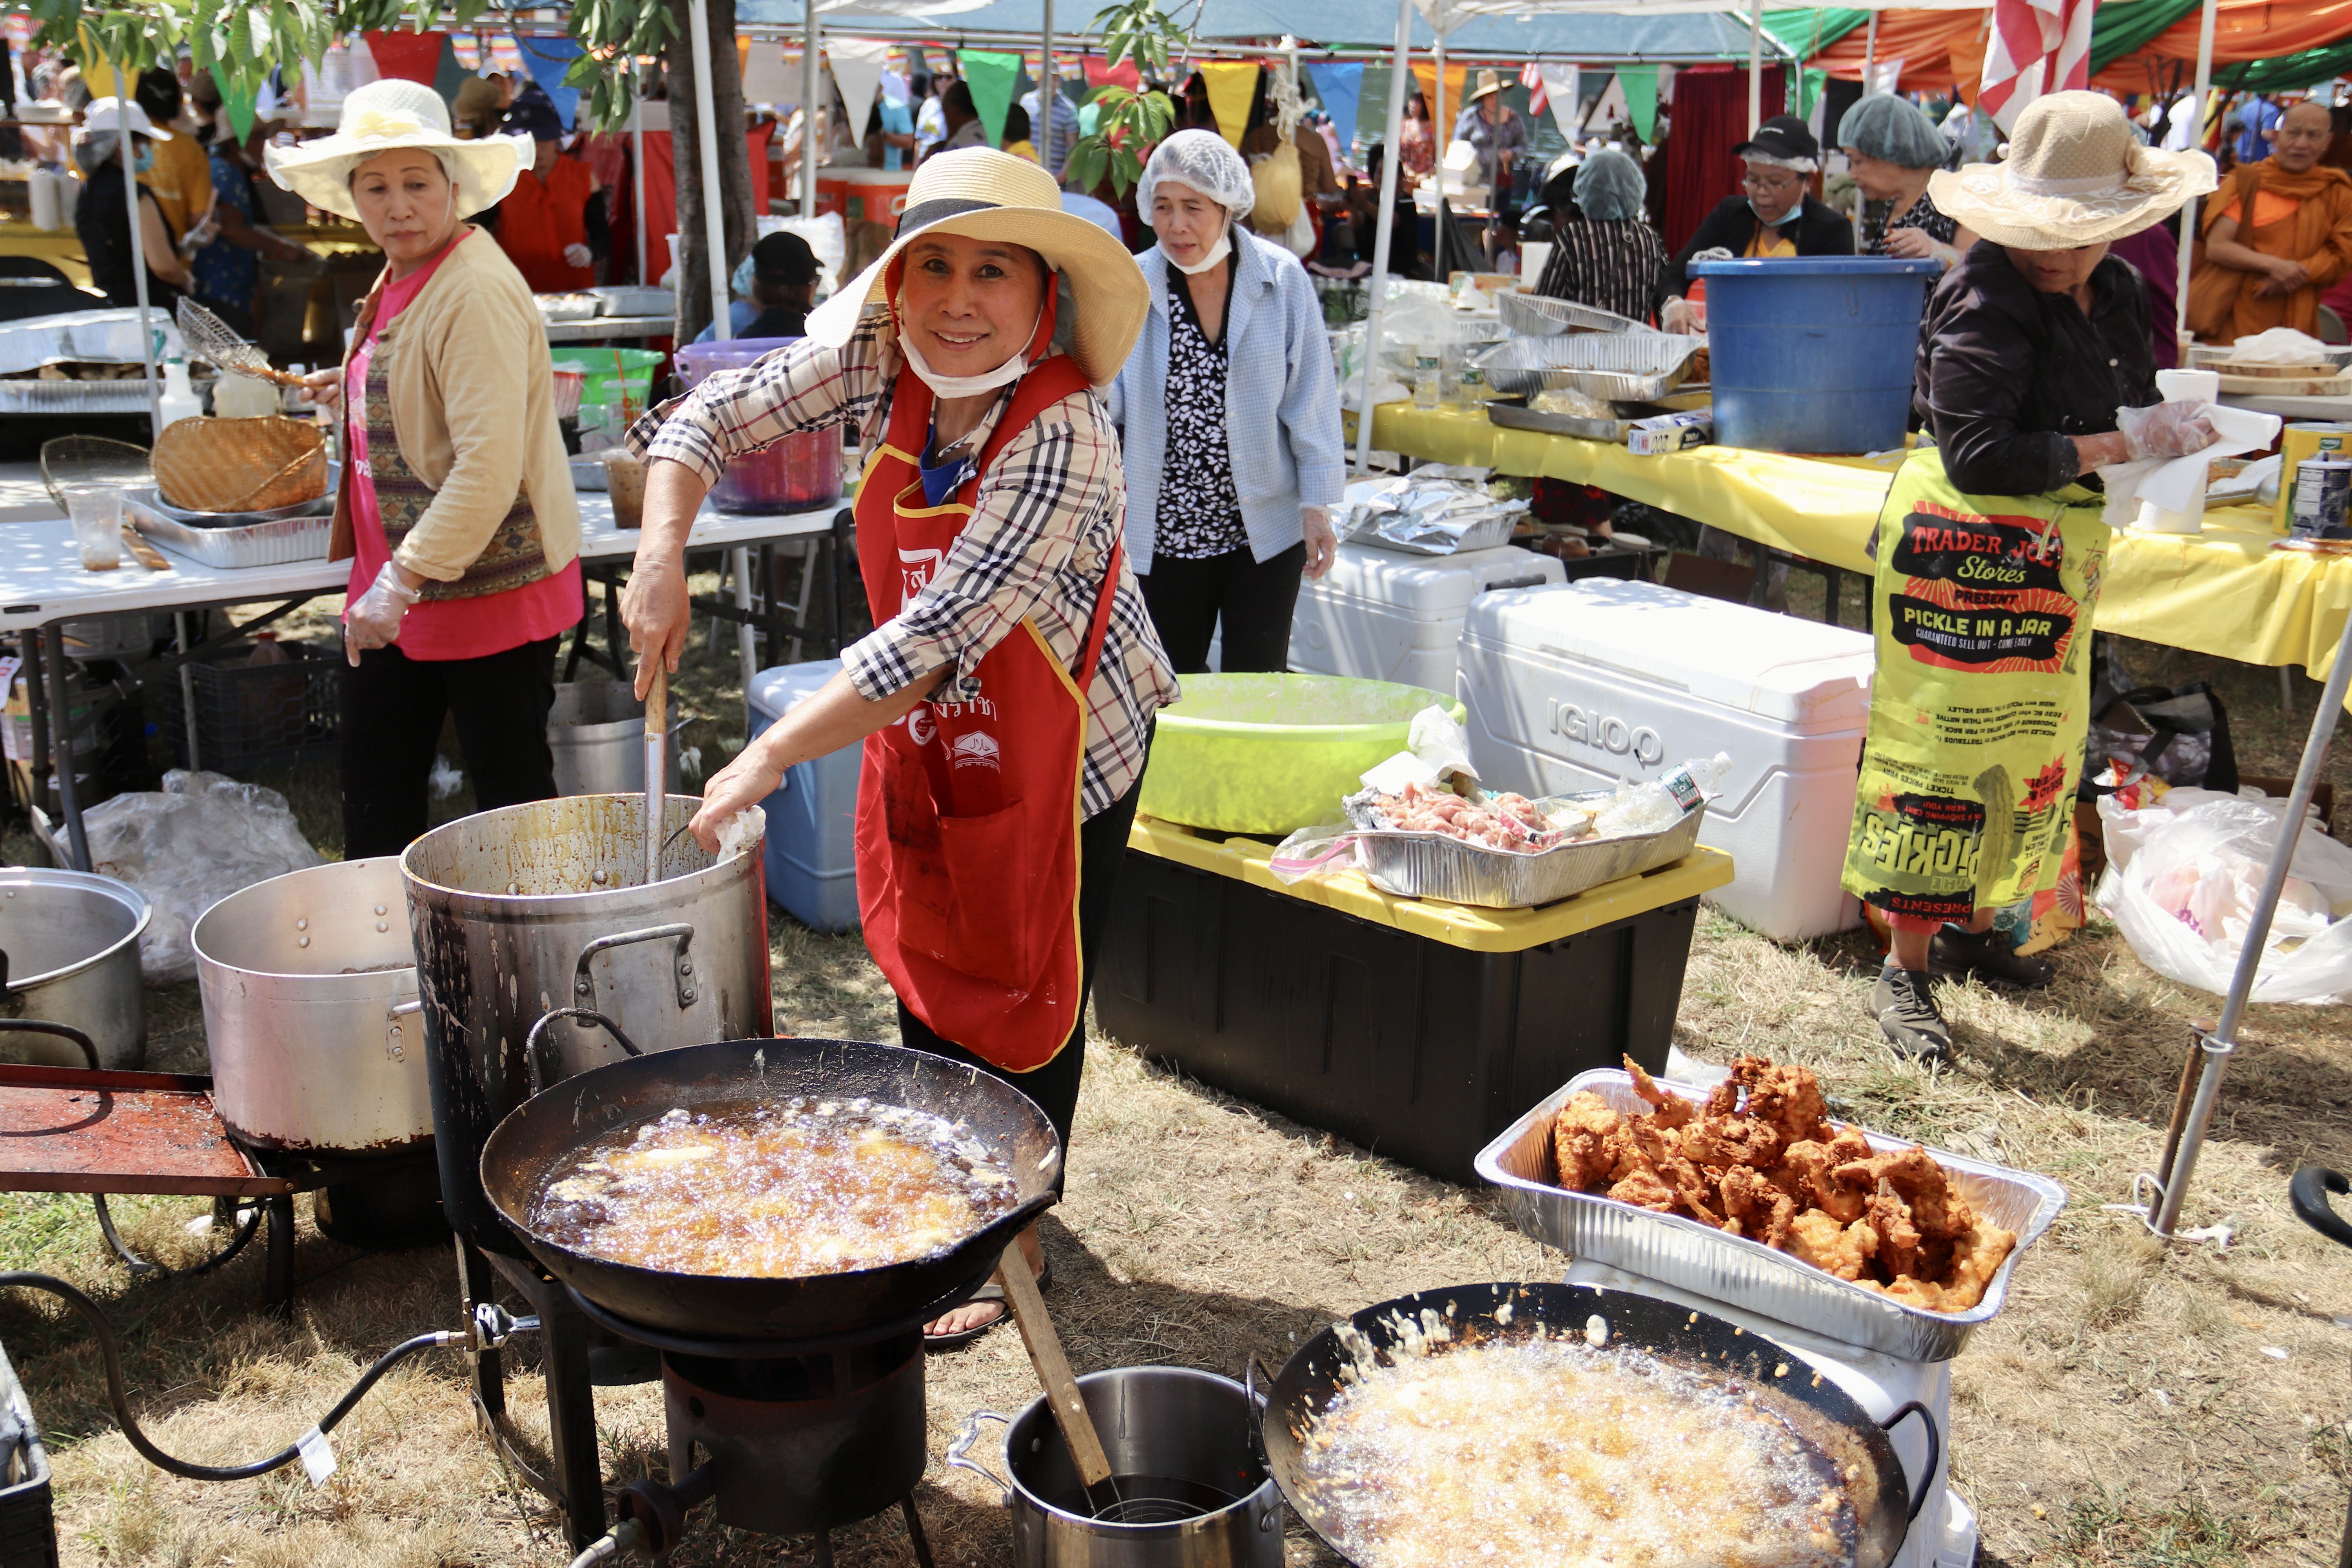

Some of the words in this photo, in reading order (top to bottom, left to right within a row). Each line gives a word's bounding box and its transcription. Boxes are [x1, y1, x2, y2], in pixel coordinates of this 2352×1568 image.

[1911, 526, 2002, 554] TRADER
[1957, 556, 2027, 583] Stores
[1954, 589, 2018, 605] PRESENT
[1904, 608, 1969, 636] PICKLE
[1976, 619, 1994, 636] IN
[2001, 619, 2012, 636] A
[2016, 618, 2052, 636] JAR
[1916, 628, 1956, 647] GUARANTEED
[1959, 638, 1975, 650] SELL
[1978, 640, 1991, 649] OUT
[1998, 639, 2014, 649] COME
[2014, 637, 2032, 647] EARLY
[1936, 714, 1960, 723] NATIVE
[1548, 697, 1663, 764] IGLOO
[1901, 775, 1923, 788] PRICES
[1926, 784, 1954, 794] TICKET
[1904, 805, 1922, 815] CART
[1922, 801, 1941, 810] YOU!
[1925, 811, 1965, 821] SHOPPING
[1931, 877, 1968, 891] THE
[1891, 897, 1971, 913] PRESENTS
